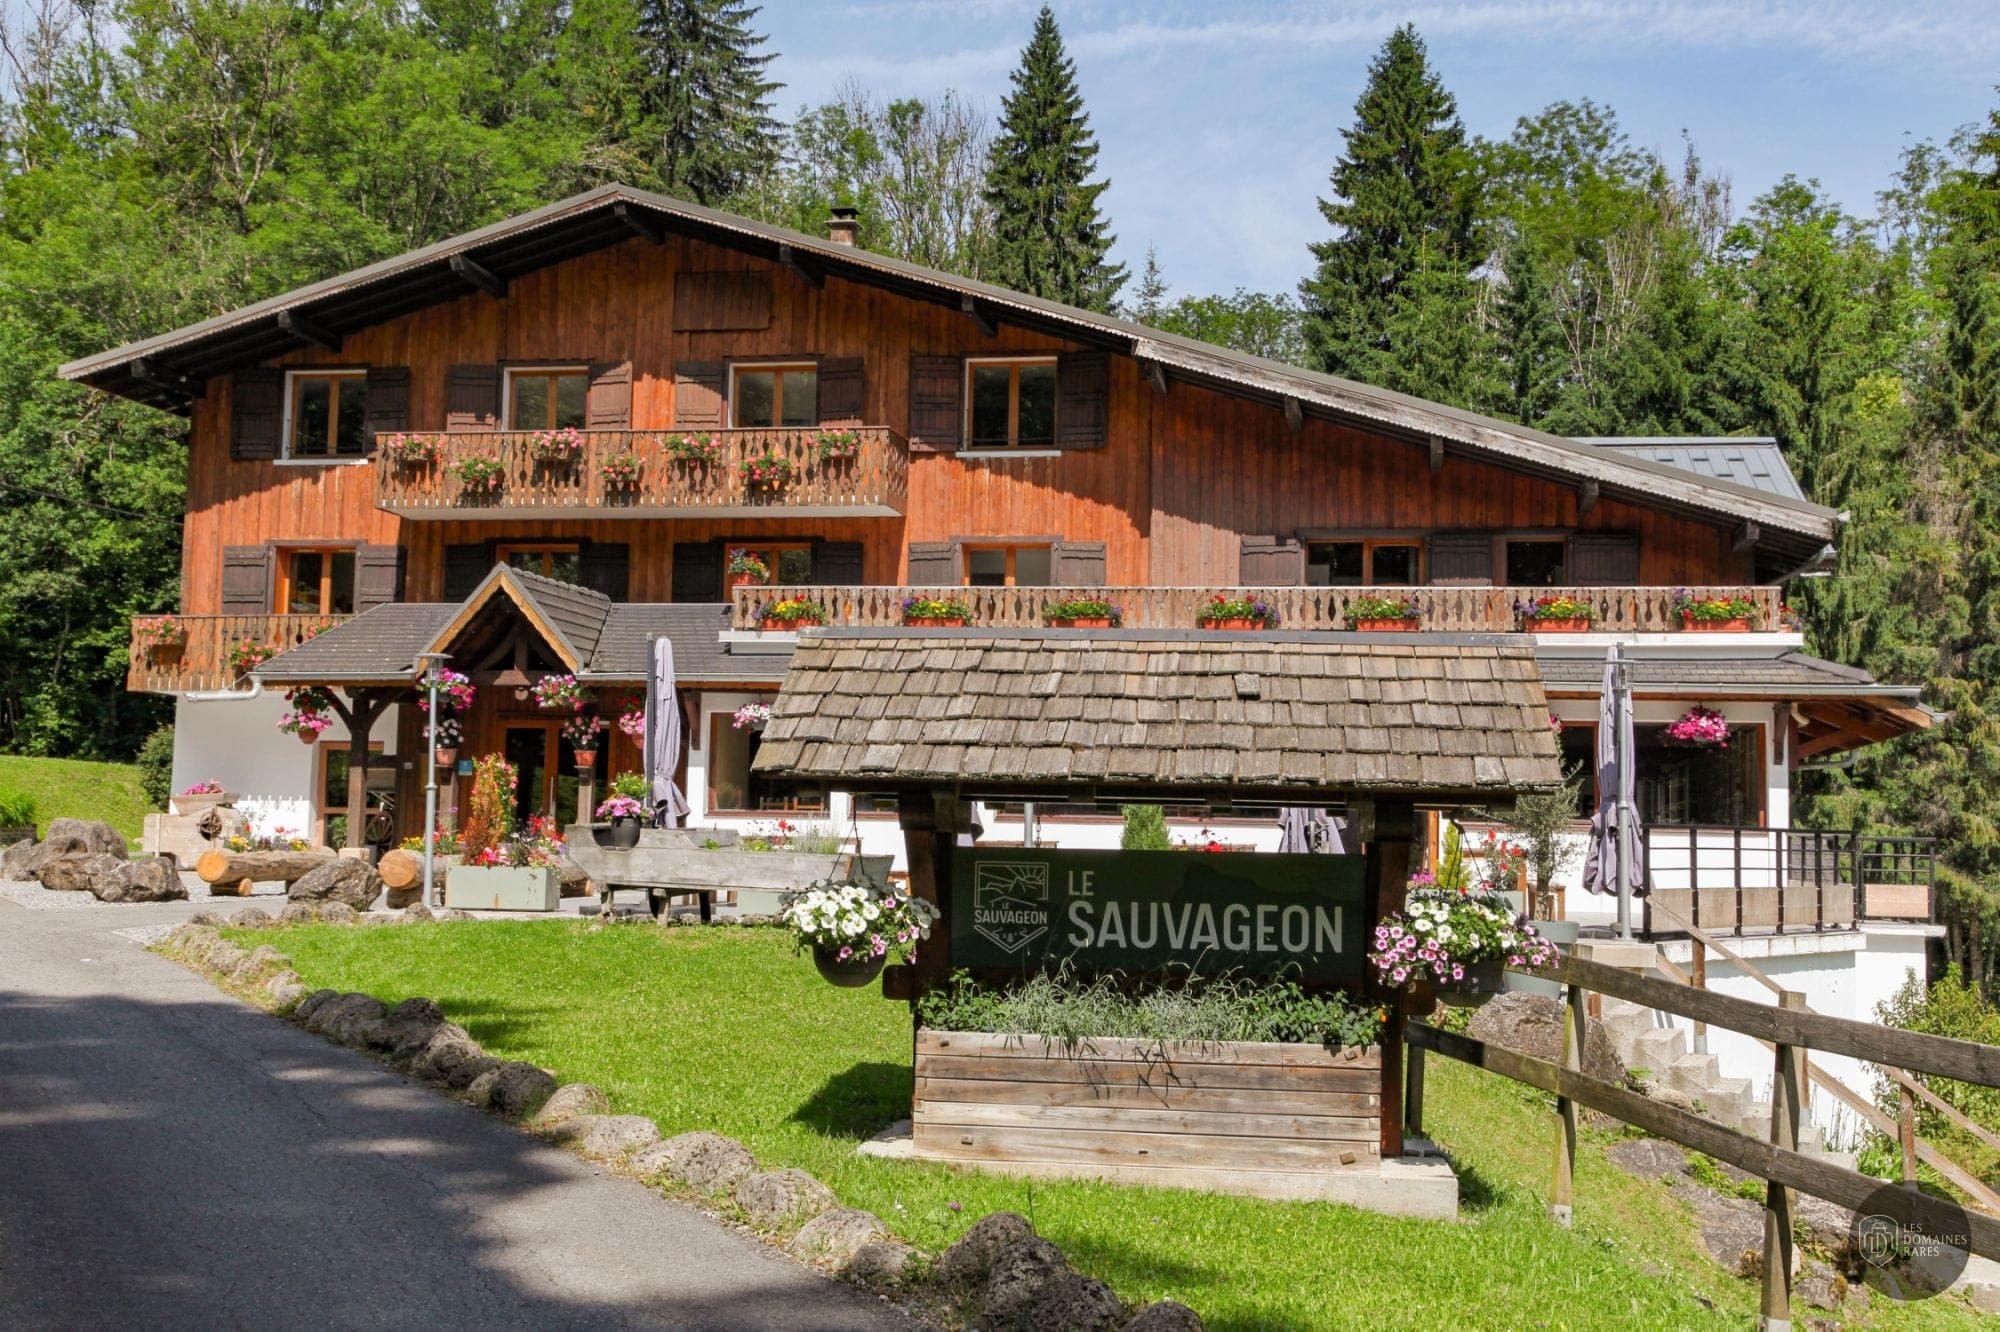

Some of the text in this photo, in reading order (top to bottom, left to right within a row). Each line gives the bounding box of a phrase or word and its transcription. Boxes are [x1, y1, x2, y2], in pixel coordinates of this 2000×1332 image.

[1068, 870, 1094, 896] LE
[974, 909, 1048, 924] SAUVAGEON
[1067, 901, 1343, 953] SAUVAGEON
